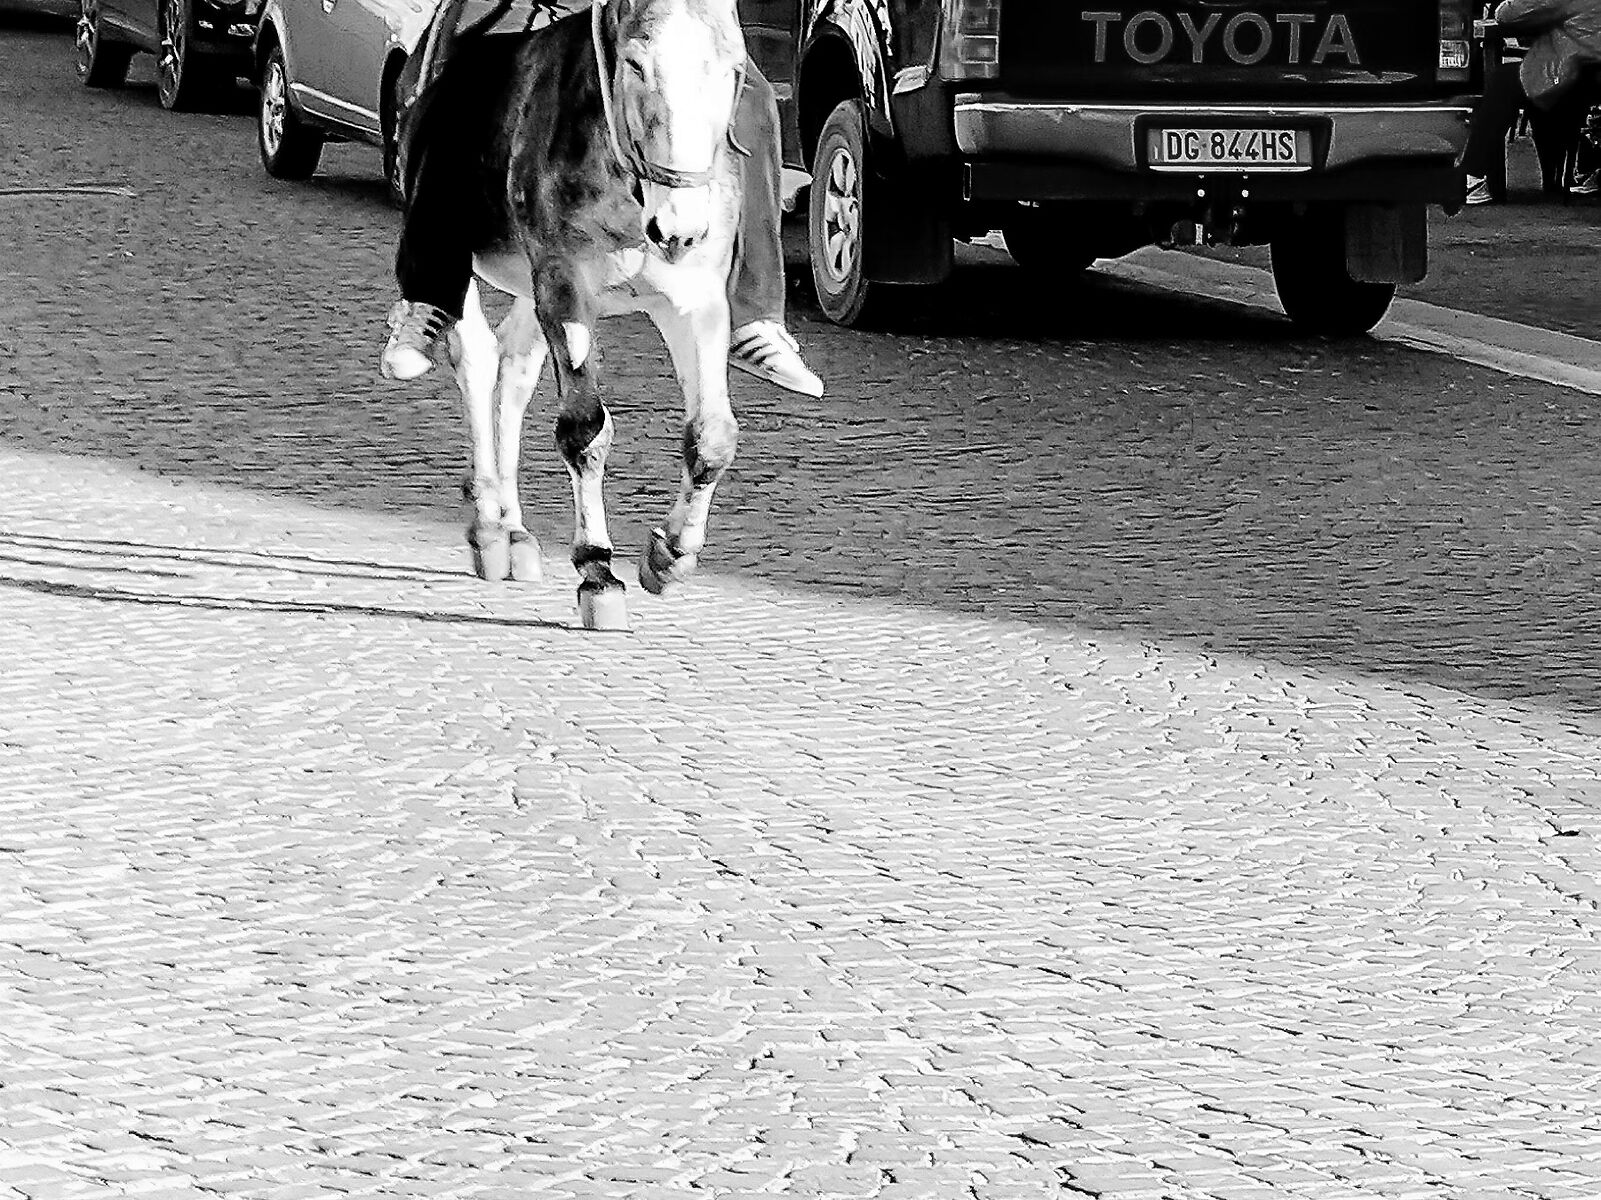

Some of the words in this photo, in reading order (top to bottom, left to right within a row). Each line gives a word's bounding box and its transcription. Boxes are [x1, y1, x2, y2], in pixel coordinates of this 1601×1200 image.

[1081, 10, 1360, 64] TOYOTA
[1167, 131, 1199, 160] DG
[1210, 131, 1295, 161] 844HS
